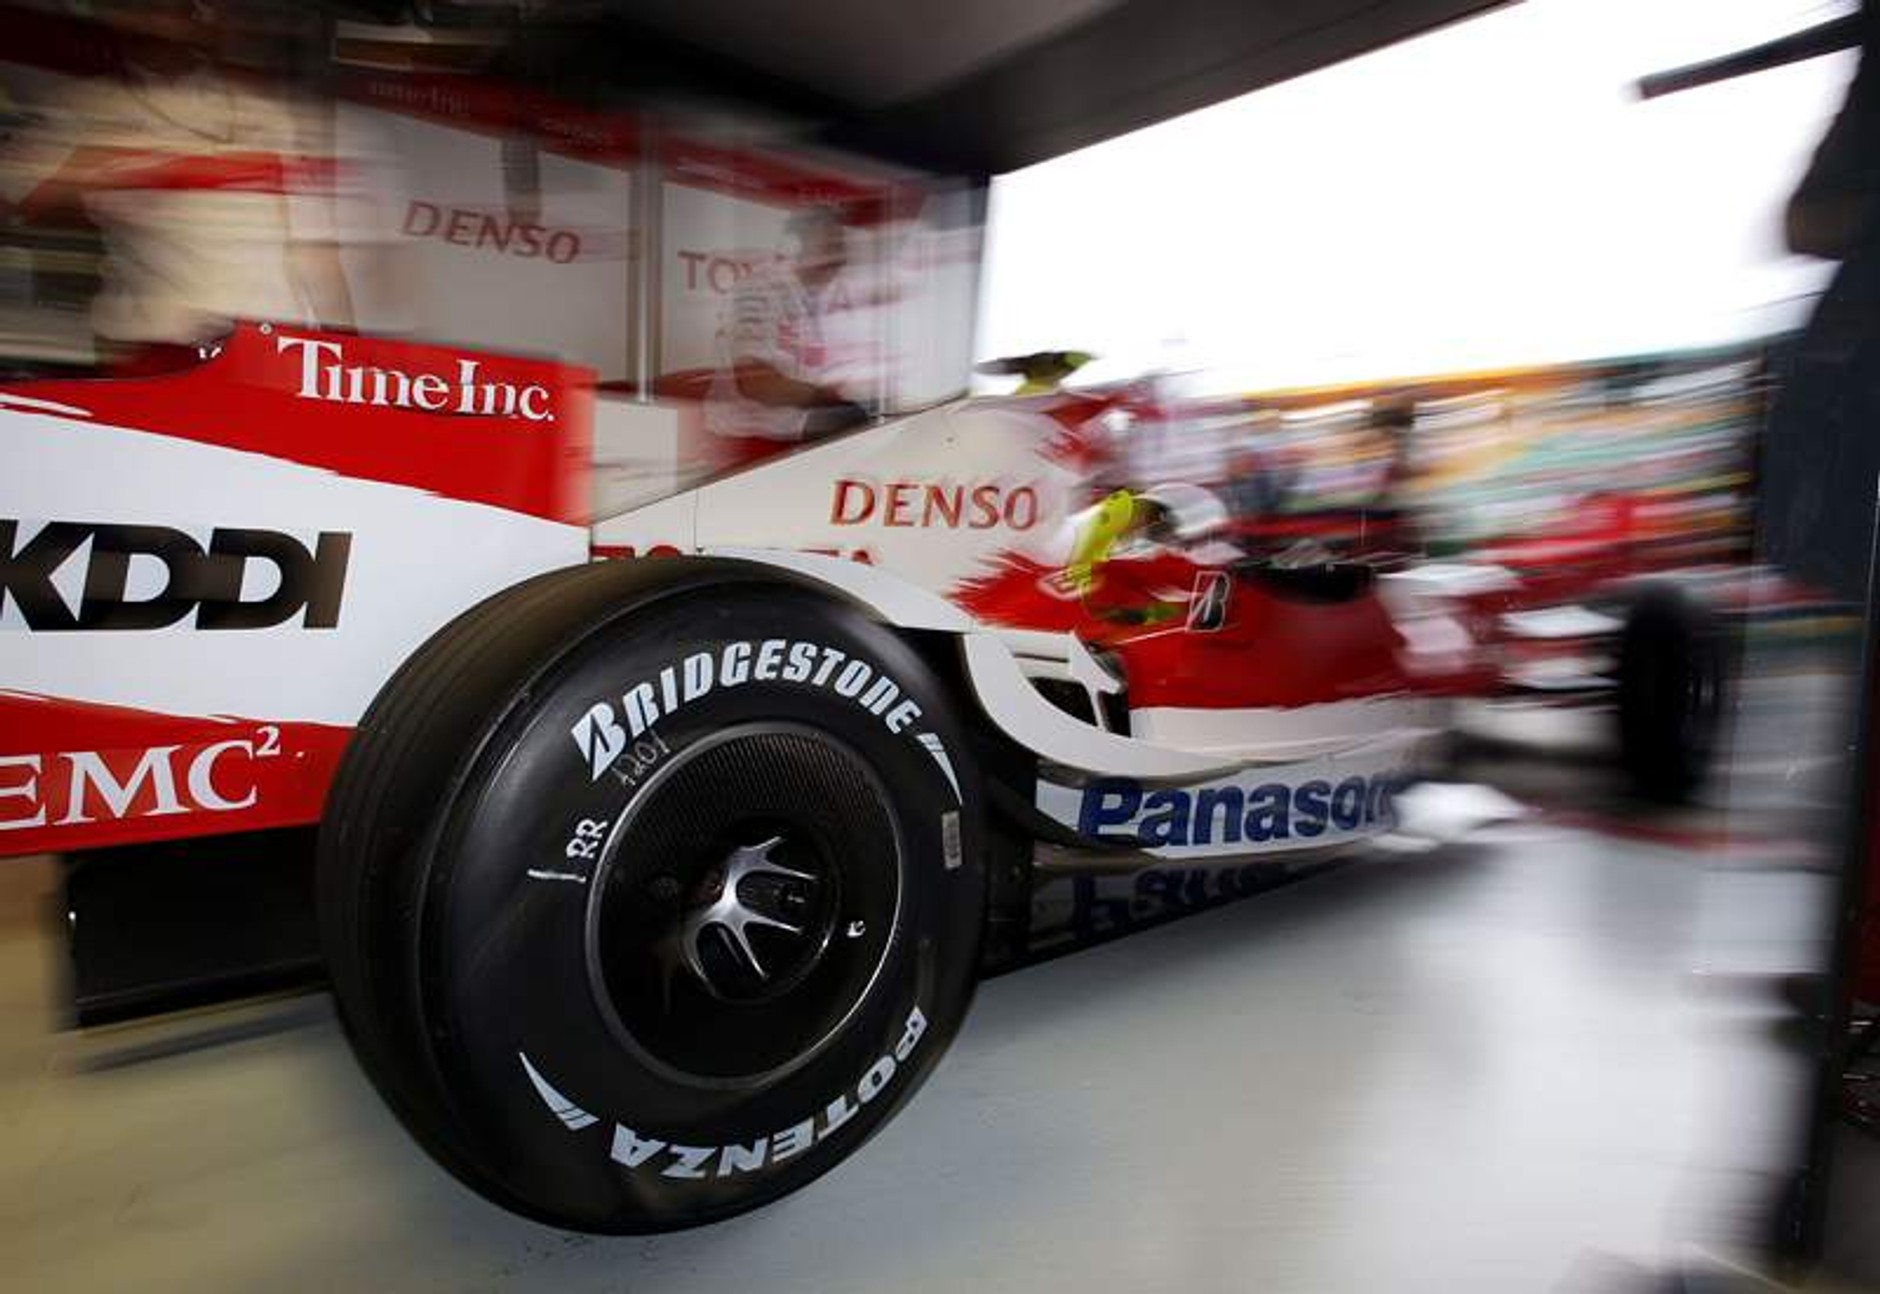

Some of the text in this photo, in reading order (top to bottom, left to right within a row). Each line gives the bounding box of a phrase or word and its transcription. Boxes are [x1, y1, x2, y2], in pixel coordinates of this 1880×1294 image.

[402, 200, 580, 265] DENSO
[277, 336, 554, 421] Time Inc.
[829, 478, 1040, 532] DENSO
[0, 519, 353, 631] KDDI
[570, 639, 922, 781] BRIDGESTONE
[566, 818, 609, 859] RR
[609, 1005, 928, 1180] POTENZA
